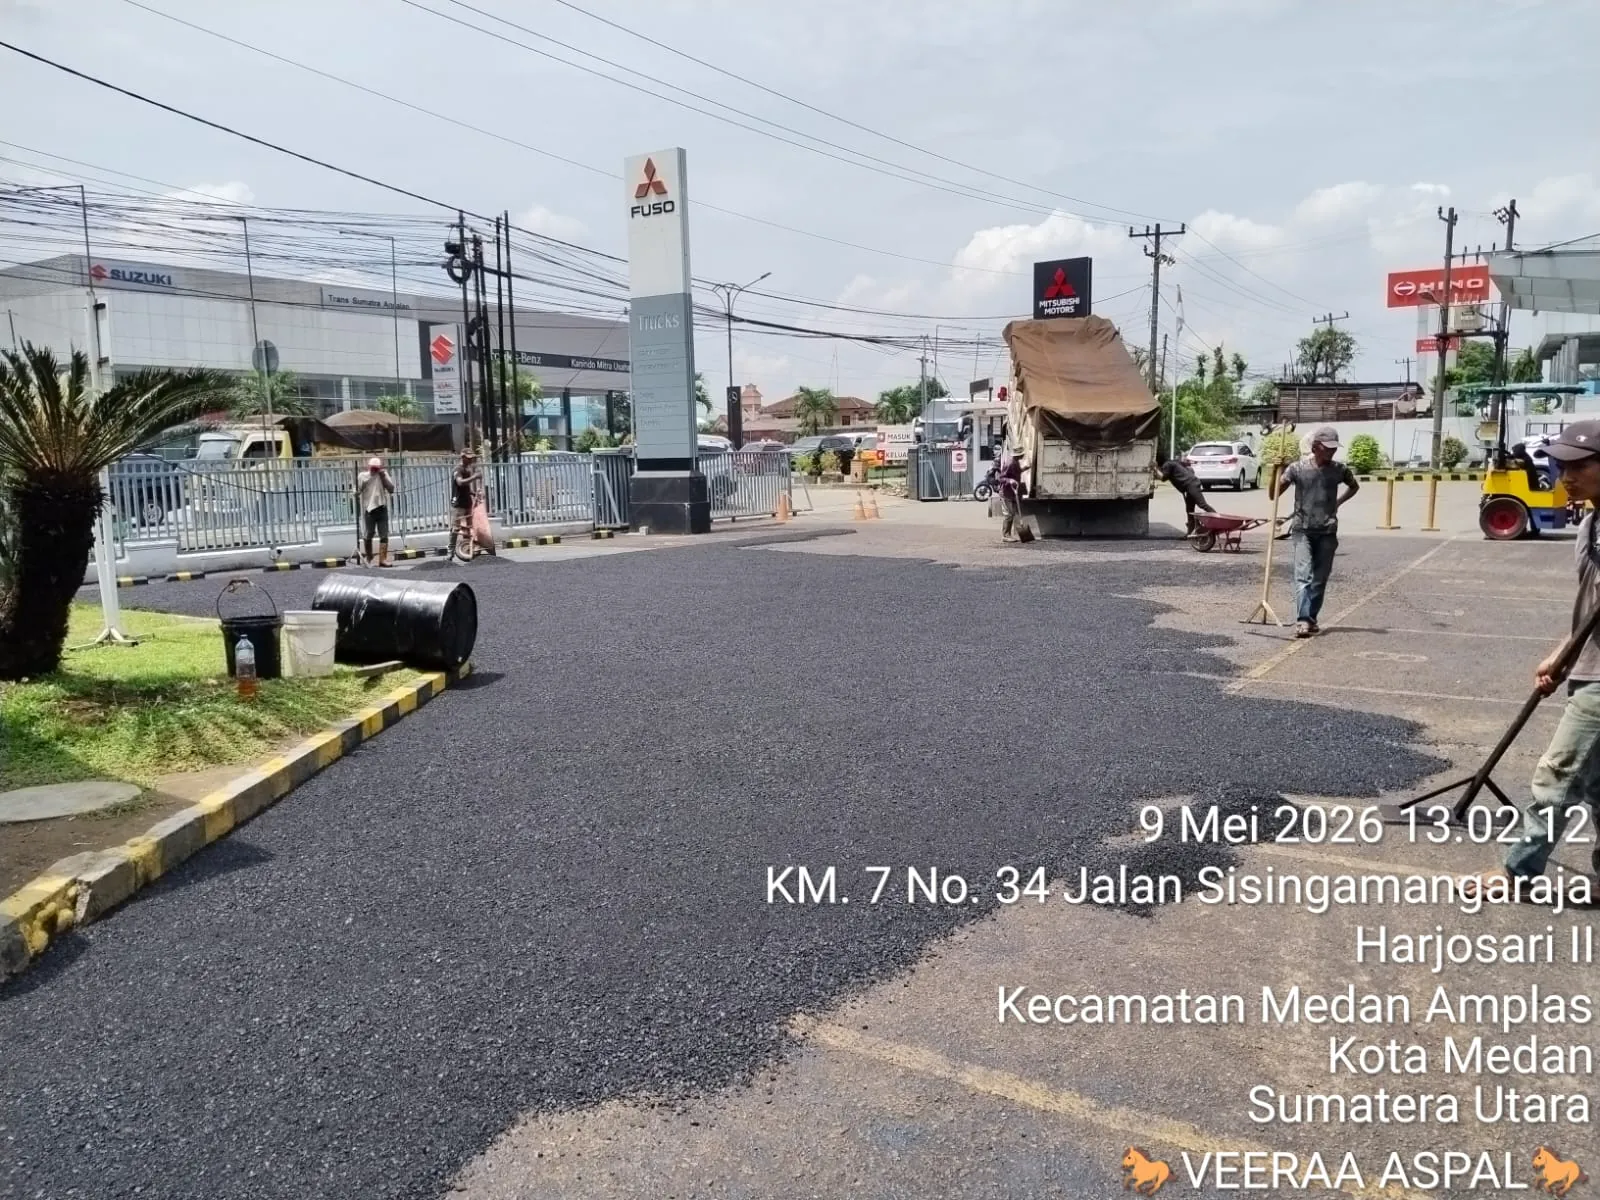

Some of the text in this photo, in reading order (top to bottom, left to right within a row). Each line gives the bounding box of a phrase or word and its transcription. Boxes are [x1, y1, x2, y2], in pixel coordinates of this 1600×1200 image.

[631, 200, 675, 218] FUSO
[110, 269, 172, 285] SUZUKI
[1420, 279, 1484, 290] HINO
[1039, 297, 1080, 308] MITSUBISHI
[1044, 306, 1075, 315] MOTORS
[639, 313, 680, 331] Trucks
[886, 449, 908, 458] KELUA
